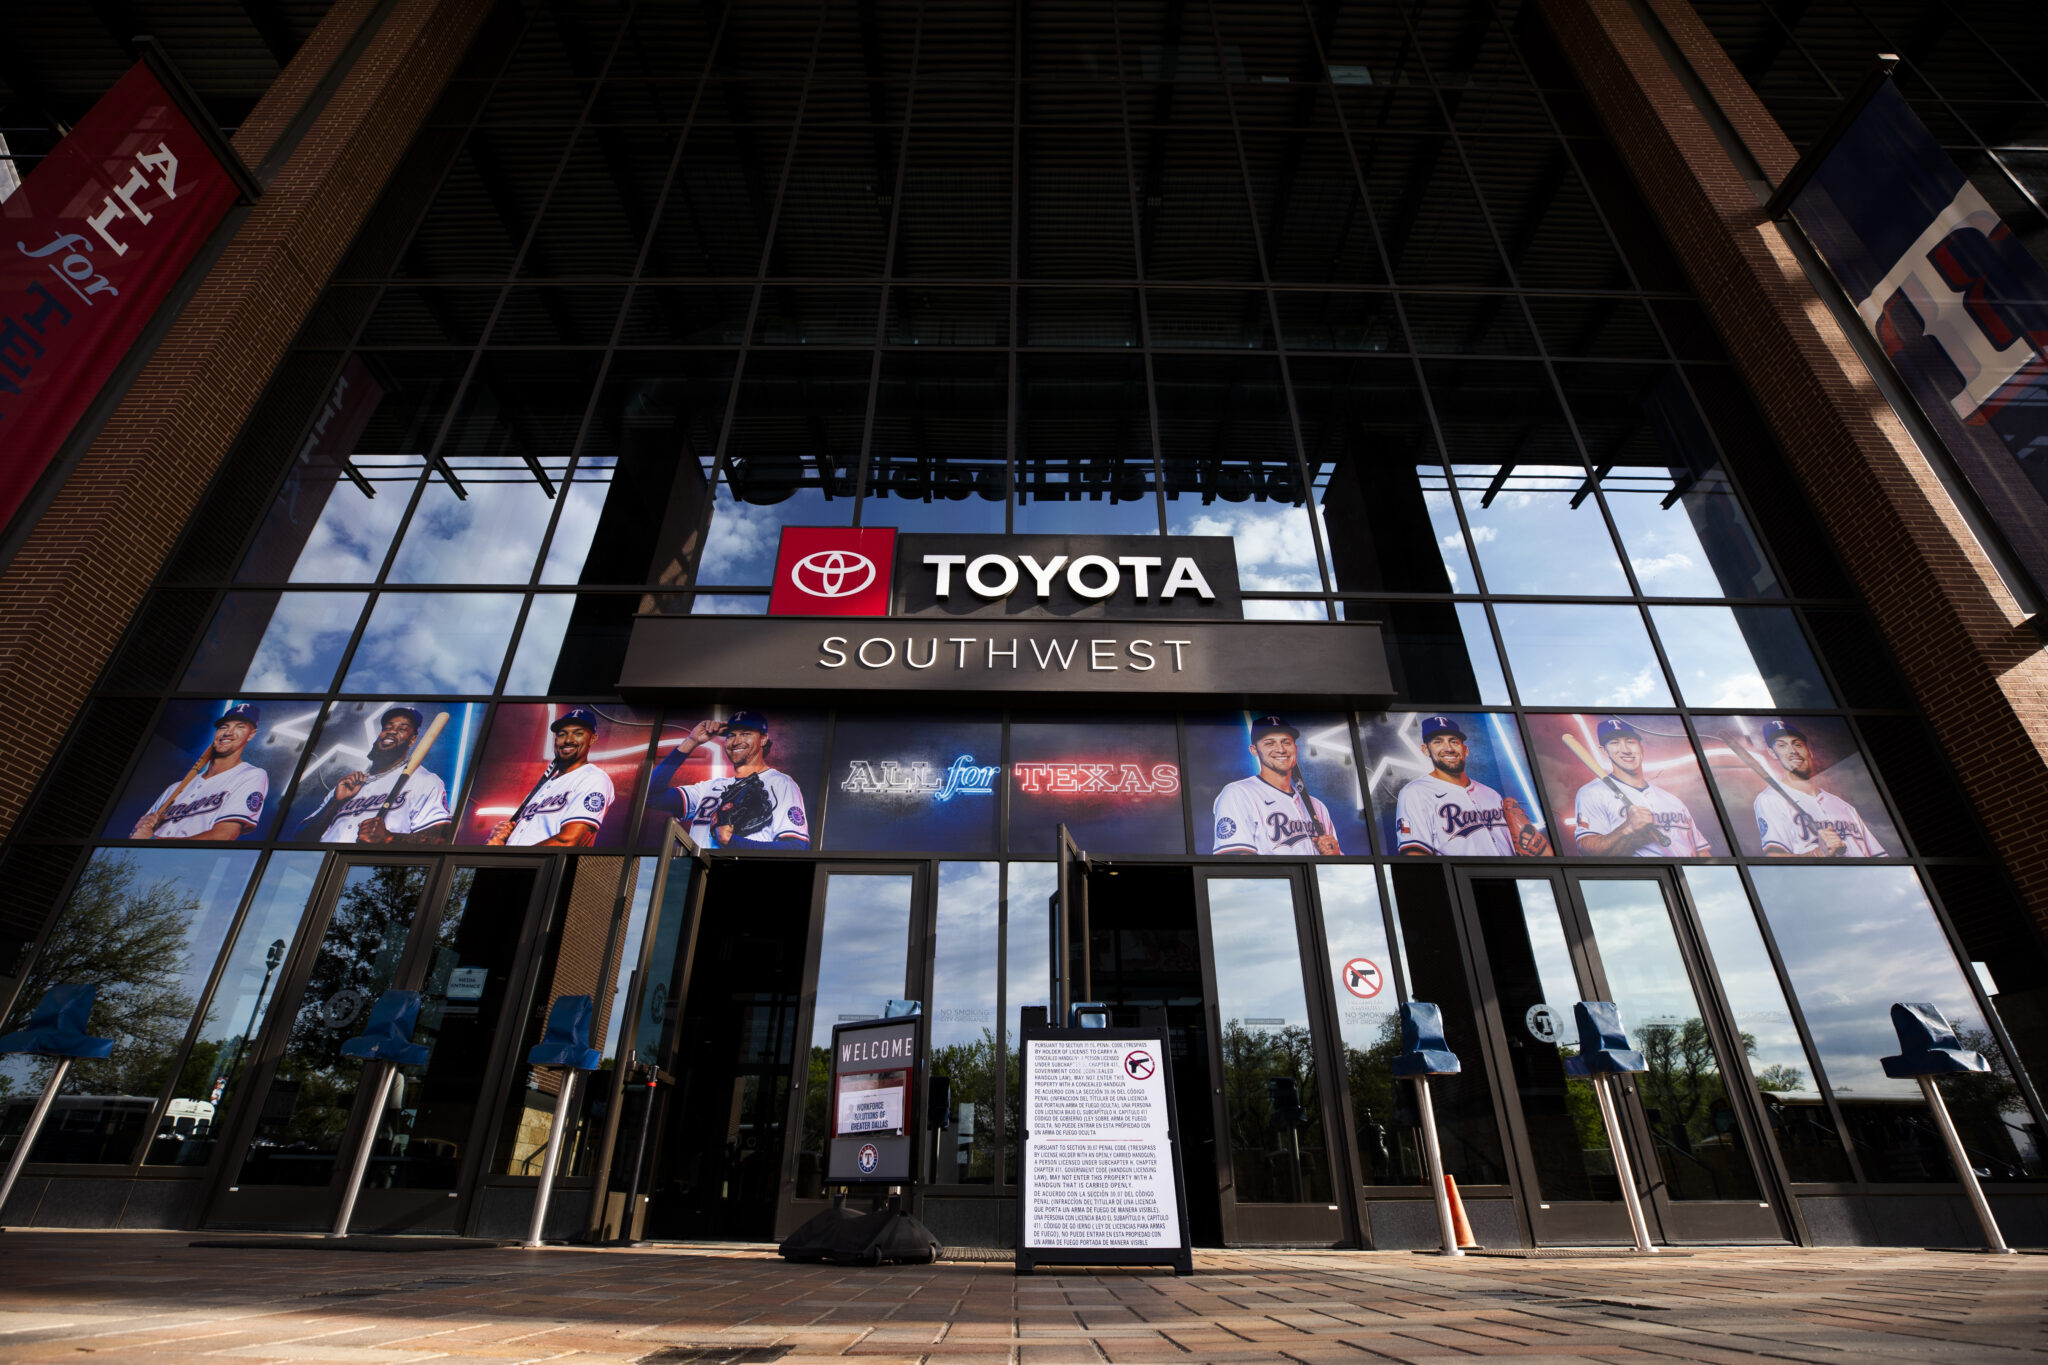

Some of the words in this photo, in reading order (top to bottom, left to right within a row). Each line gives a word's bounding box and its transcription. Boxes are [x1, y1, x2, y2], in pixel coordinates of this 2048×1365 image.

[86, 141, 180, 257] ALL
[16, 230, 119, 300] for
[924, 555, 1214, 597] TOYOTA
[820, 637, 1190, 670] SOUTHWEST
[236, 703, 250, 713] T
[571, 709, 584, 718] T
[1434, 716, 1448, 727] T
[1608, 719, 1621, 730] T
[841, 761, 941, 793] ALL
[936, 754, 1001, 801] for
[1015, 763, 1180, 794] TEXAS
[162, 791, 228, 820] angers
[1438, 803, 1505, 837] Ranger
[940, 1008, 952, 1016] NO
[842, 1037, 912, 1062] WELCOME
[857, 1101, 884, 1111] WORKFORCE
[854, 1111, 878, 1121] SOLUTIONS
[879, 1110, 886, 1119] OF
[851, 1121, 870, 1131] GREATER
[871, 1120, 888, 1129] DALLAS
